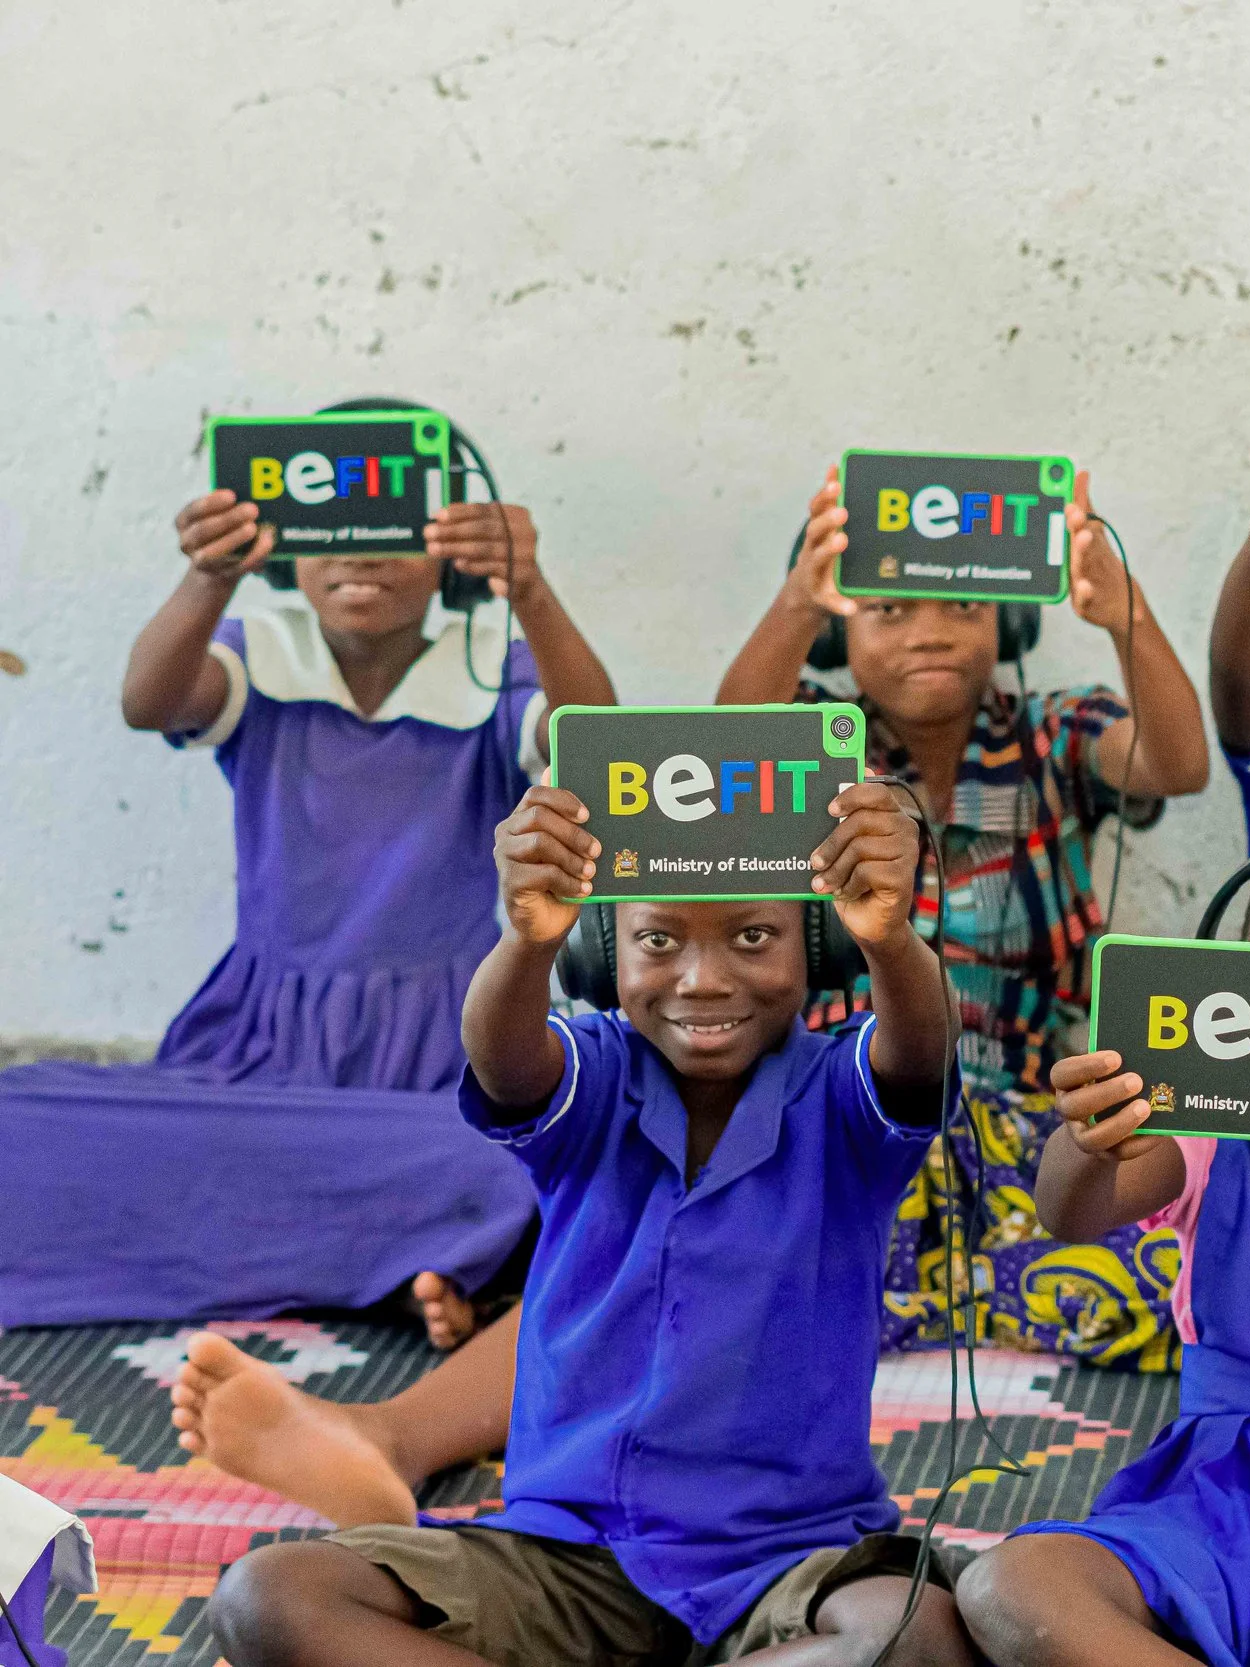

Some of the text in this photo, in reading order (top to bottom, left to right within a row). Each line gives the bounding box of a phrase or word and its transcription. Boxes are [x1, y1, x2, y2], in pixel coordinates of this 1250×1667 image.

[251, 451, 414, 504] BeFIT
[878, 485, 1038, 538] BeFIT
[608, 754, 819, 821] BeFIT
[650, 858, 713, 875] Ministry
[718, 858, 735, 871] of
[1185, 1095, 1249, 1114] Ministry
